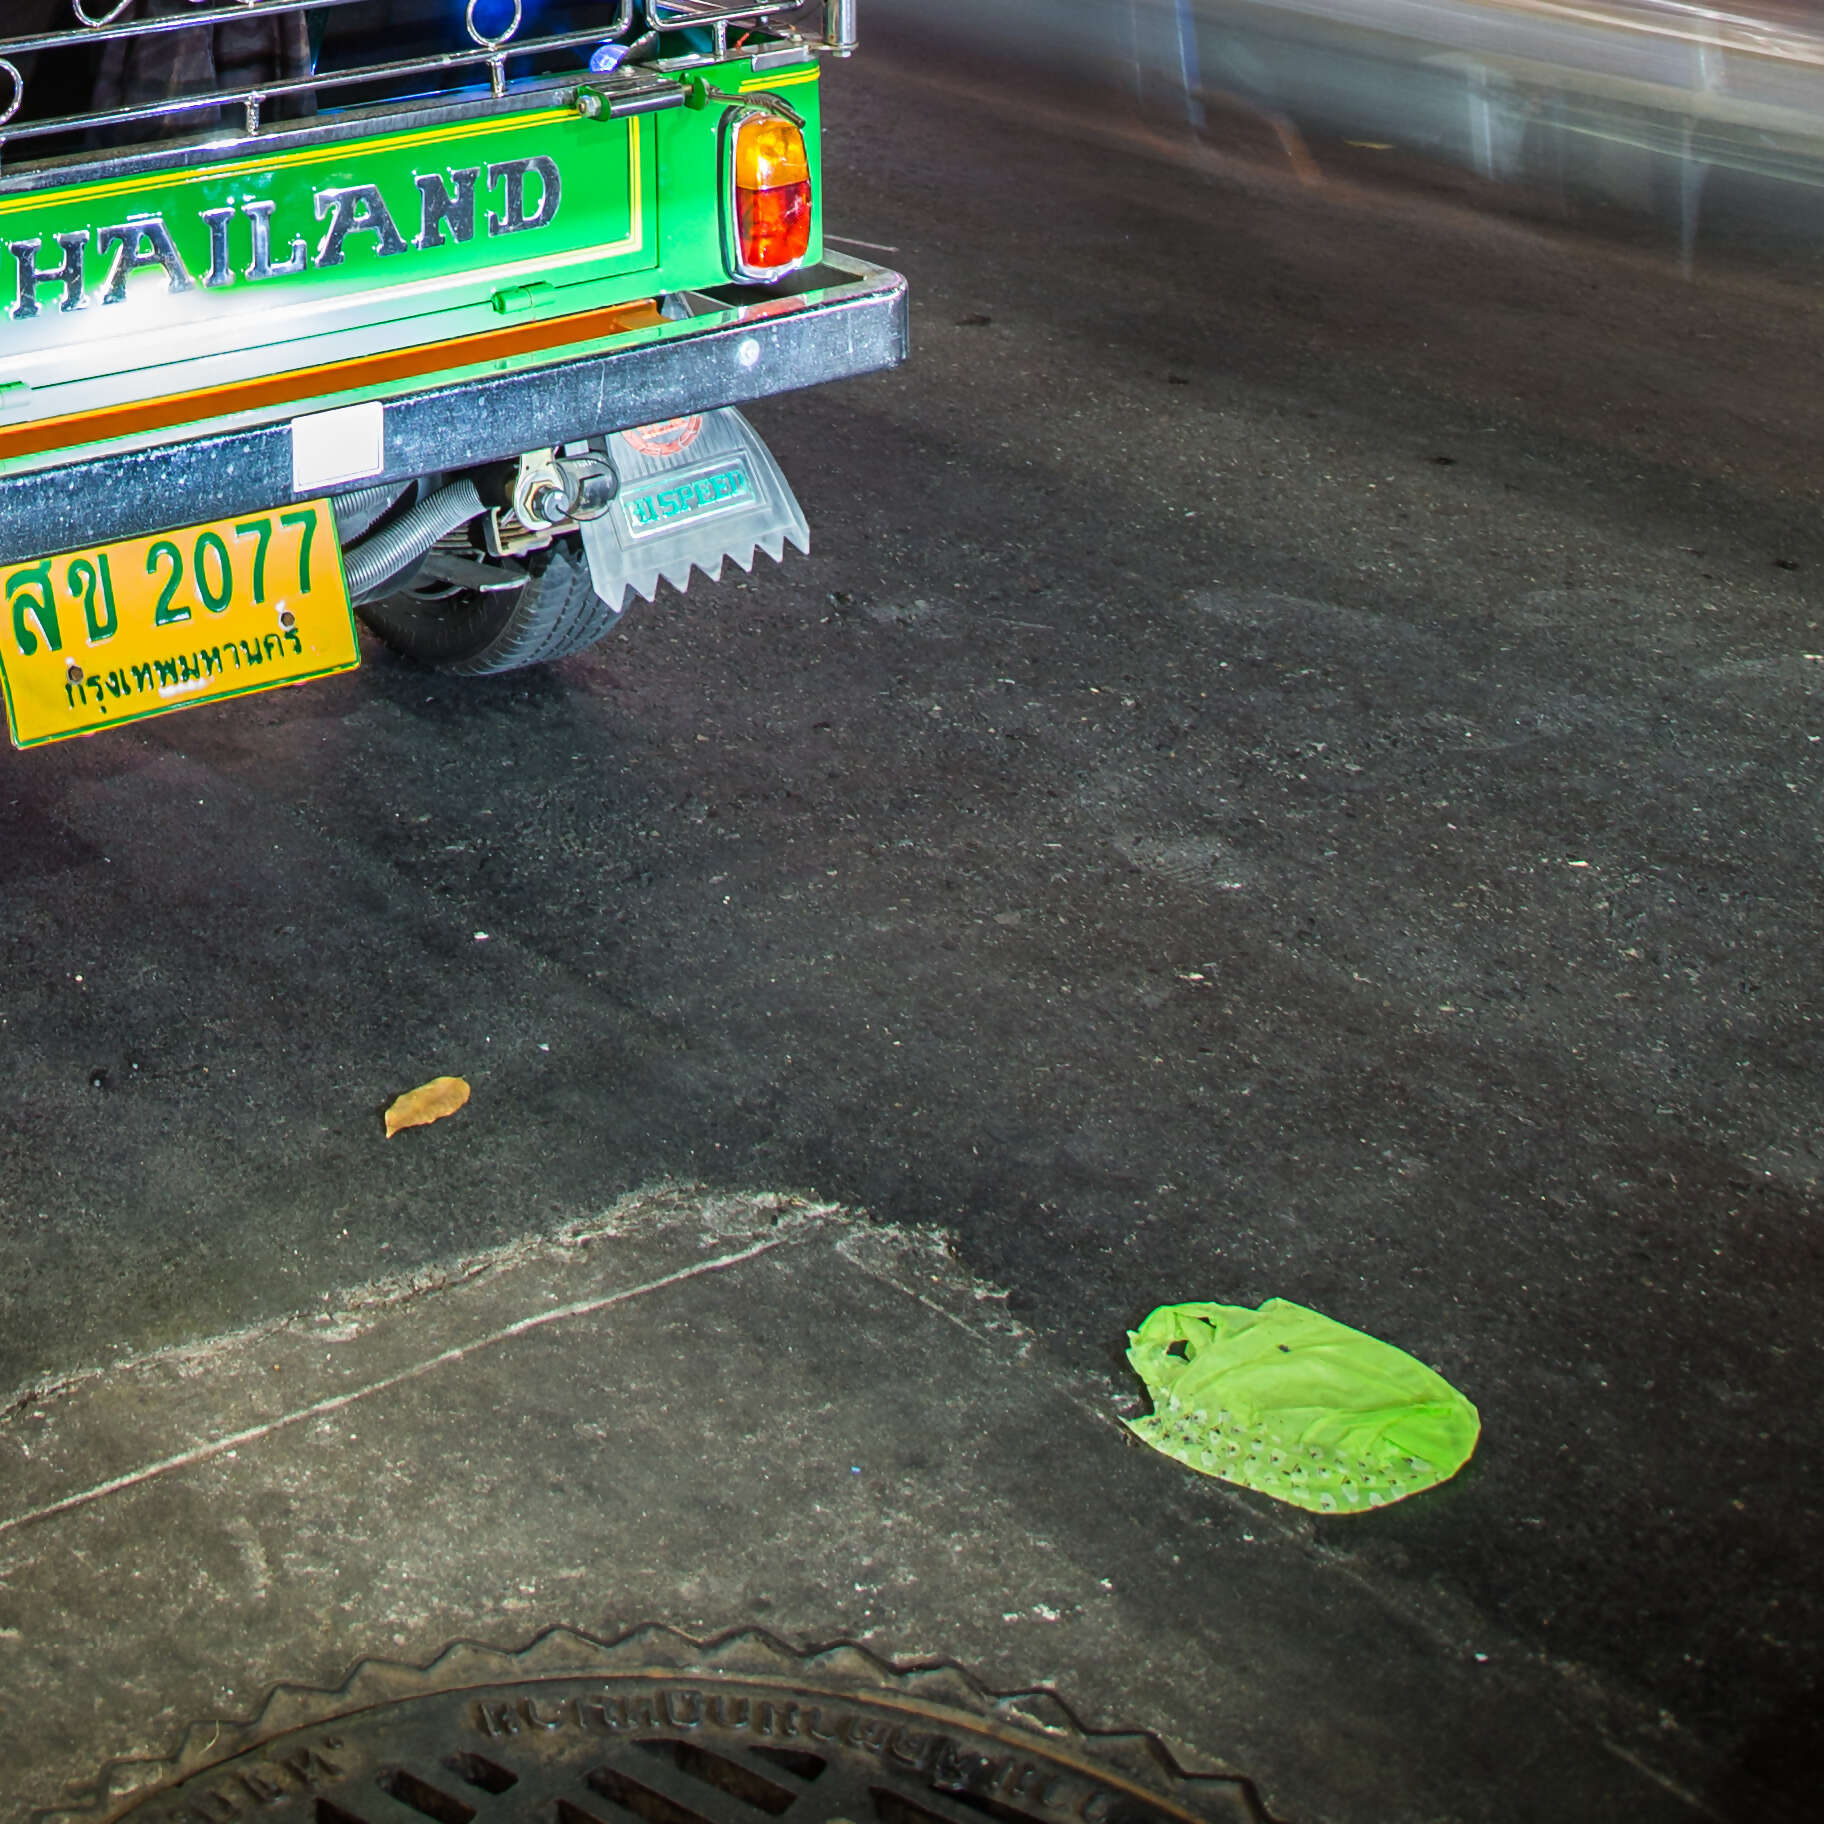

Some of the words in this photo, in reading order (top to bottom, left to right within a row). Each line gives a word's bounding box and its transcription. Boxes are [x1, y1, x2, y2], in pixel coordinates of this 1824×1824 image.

[658, 470, 746, 516] SPEED
[146, 509, 318, 626] 2077
[65, 626, 303, 713] กรุงเทพมหานคร
